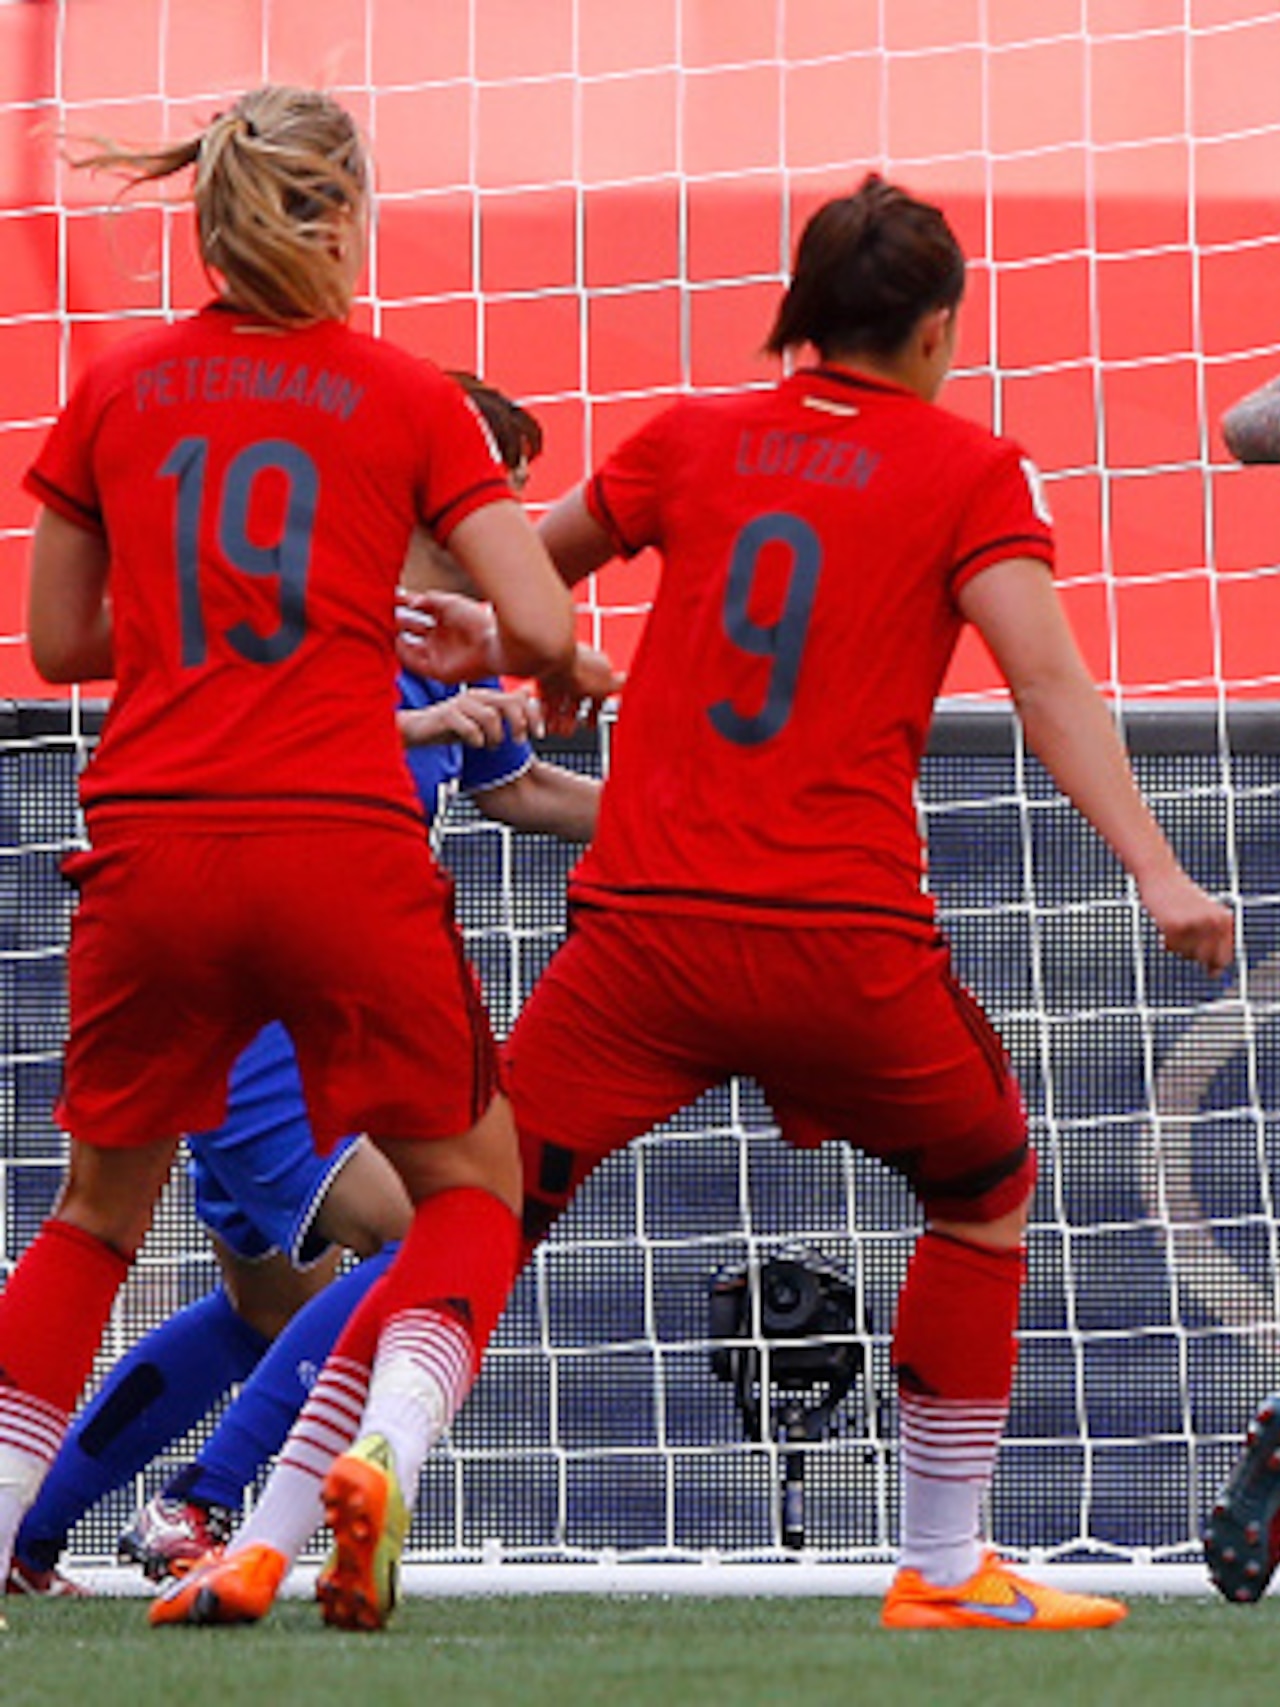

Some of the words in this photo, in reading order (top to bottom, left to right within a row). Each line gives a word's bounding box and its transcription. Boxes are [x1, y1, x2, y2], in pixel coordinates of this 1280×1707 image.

[135, 357, 366, 421] PETERMANN
[736, 429, 883, 491] LOTZEN
[157, 436, 321, 669] 19
[706, 512, 822, 747] 9
